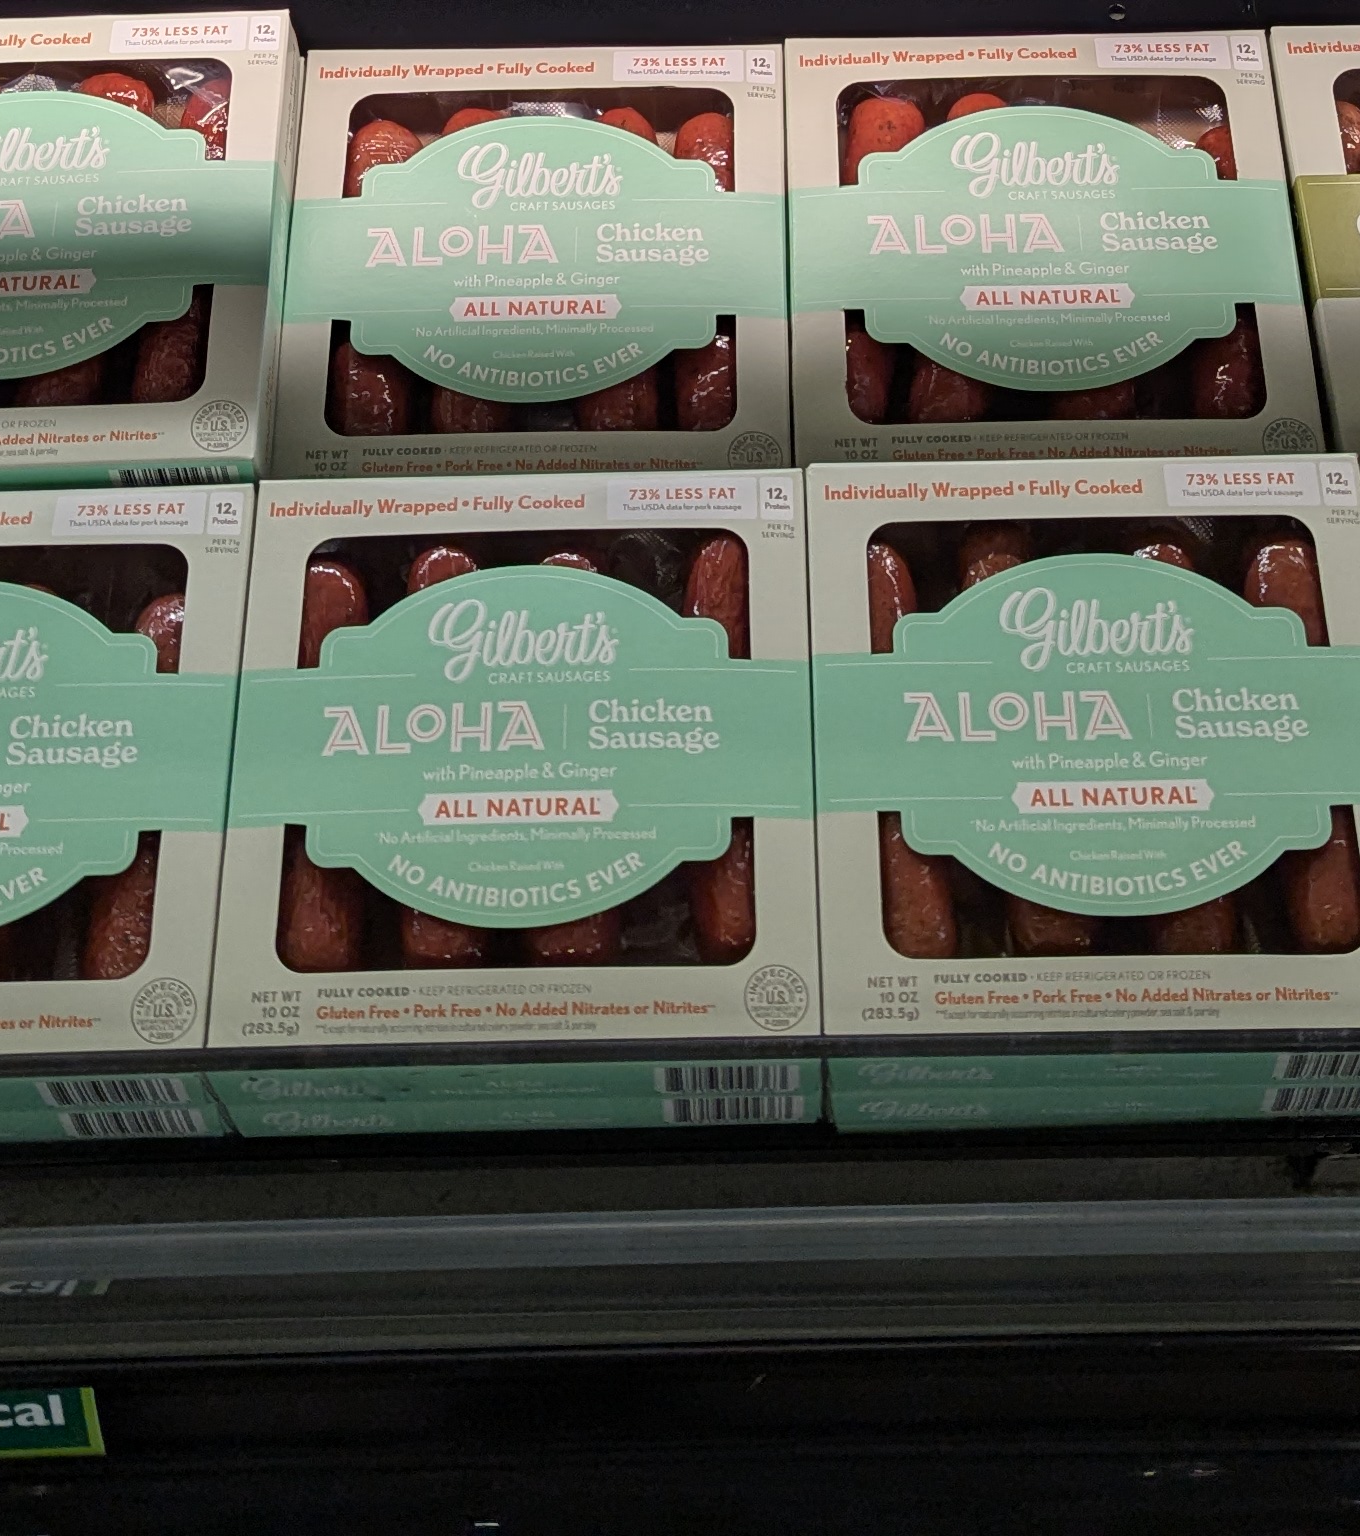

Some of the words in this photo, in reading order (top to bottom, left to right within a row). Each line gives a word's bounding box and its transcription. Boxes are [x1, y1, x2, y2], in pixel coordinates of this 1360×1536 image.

[31, 32, 91, 47] Cooked
[130, 26, 159, 37] 73%
[164, 25, 199, 36] LESS
[203, 25, 228, 35] FAT
[458, 143, 622, 209] Gilbert's
[951, 132, 1120, 198] Gilbert's
[365, 224, 558, 267] ALOHA
[867, 213, 1064, 255] ALOHA
[429, 599, 617, 682] Gilbert's
[1000, 587, 1193, 672] Gilbert's
[321, 700, 544, 756] ALOHA
[904, 690, 1131, 742] ALOHA
